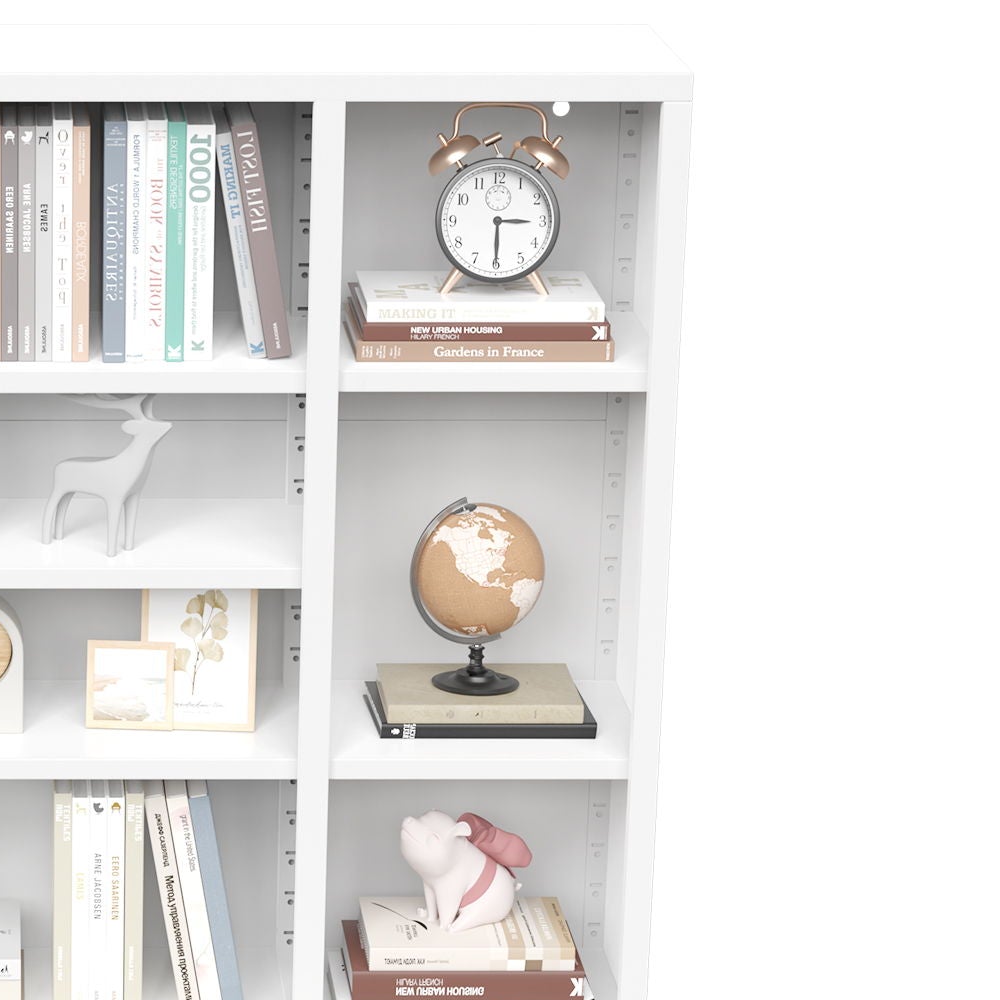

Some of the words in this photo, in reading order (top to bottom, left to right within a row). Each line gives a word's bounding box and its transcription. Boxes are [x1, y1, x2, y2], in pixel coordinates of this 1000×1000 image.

[474, 177, 484, 190] 11
[493, 172, 506, 185] 12
[518, 178, 523, 189] 1
[457, 193, 469, 205] 10
[533, 194, 541, 205] 2
[449, 215, 457, 227] 9
[538, 215, 547, 227] 3
[454, 236, 463, 248] 8
[530, 237, 539, 248] 4
[471, 252, 479, 264] 7
[492, 258, 500, 269] 6
[517, 252, 525, 264] 5
[410, 326, 430, 334] NEW
[432, 326, 461, 334] URBAN
[463, 326, 503, 335] HOUSING
[433, 347, 484, 357] Gardens
[487, 347, 499, 357] in
[502, 347, 544, 357] France
[165, 875, 174, 904] Метод
